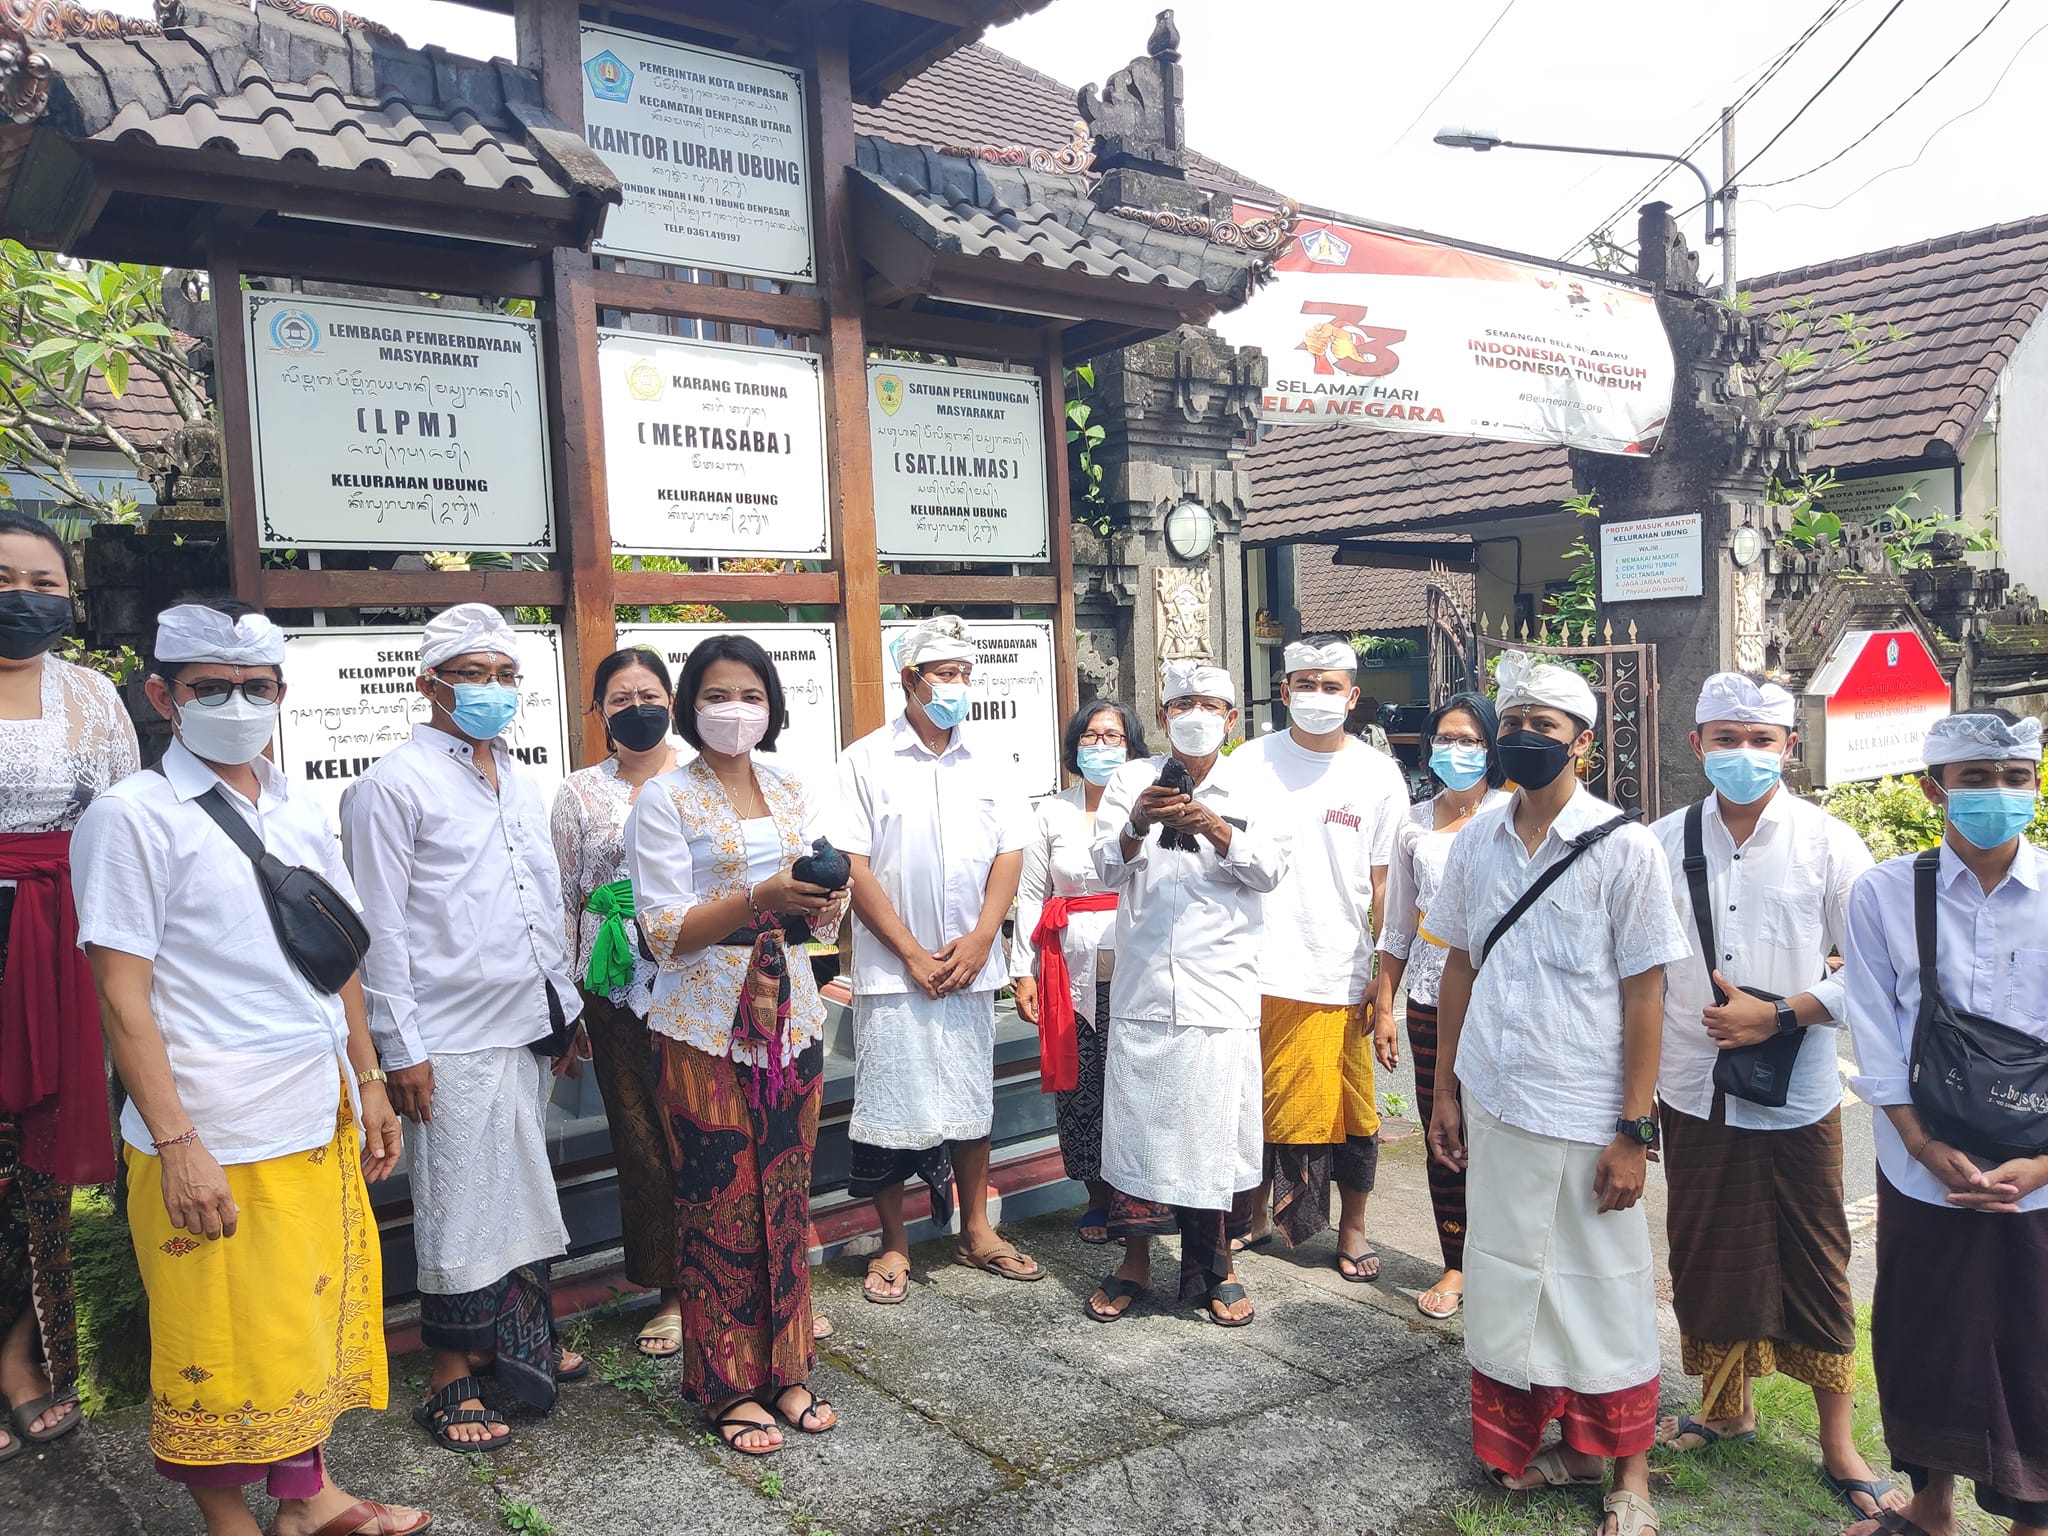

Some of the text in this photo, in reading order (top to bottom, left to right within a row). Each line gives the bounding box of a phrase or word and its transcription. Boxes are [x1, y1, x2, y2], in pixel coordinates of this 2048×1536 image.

[639, 61, 707, 84] PEMERINTAH
[708, 76, 736, 91] KOTA
[737, 82, 789, 102] DENPASAR
[639, 94, 704, 116] KECAMATAN
[705, 107, 759, 127] DENPASAR
[760, 119, 793, 134] UTARA
[588, 124, 669, 162] KANTOR
[673, 140, 734, 174] LURAH
[738, 152, 800, 186] UBUNG
[658, 188, 686, 200] INDAH
[692, 194, 708, 204] NO.
[715, 198, 745, 210] UBUNG
[746, 203, 791, 217] DENPASAR
[664, 223, 686, 234] TELP.
[328, 323, 523, 354] LEMBAGA PEMBERDAYAAN
[1484, 328, 1547, 344] SEMANGAT
[379, 347, 480, 369] MASYARAKAT
[1467, 338, 1567, 364] INDONESIA
[1474, 354, 1573, 379] INDONESIA
[672, 375, 789, 399] KARANG TARUNA
[908, 382, 1030, 404] SATUAN PERLINDUNGAN
[1276, 379, 1420, 402] SELAMAT HARI
[936, 404, 1006, 420] MASYARAKAT
[1261, 396, 1446, 424] ELA NEGARA
[331, 473, 489, 492] KELURAHAN UBUNG
[657, 488, 779, 506] KELURAHAN UBUNG
[1829, 491, 1853, 500] KOTA
[1856, 485, 1905, 496] DENPASAR
[910, 504, 1008, 518] KELURAHAN UBUNG
[1605, 518, 1697, 535] PROTAP MASUK KANTOR
[1613, 528, 1688, 543] KELURAHAN UBUNG
[1638, 570, 1665, 578] TANGAN
[1655, 561, 1677, 569] TUBUH
[1639, 578, 1661, 586] JARAK
[377, 650, 422, 662] SEKRE
[338, 666, 417, 679] KELOMPOK
[360, 681, 421, 695] KELURA
[1324, 808, 1362, 832] JANGAR
